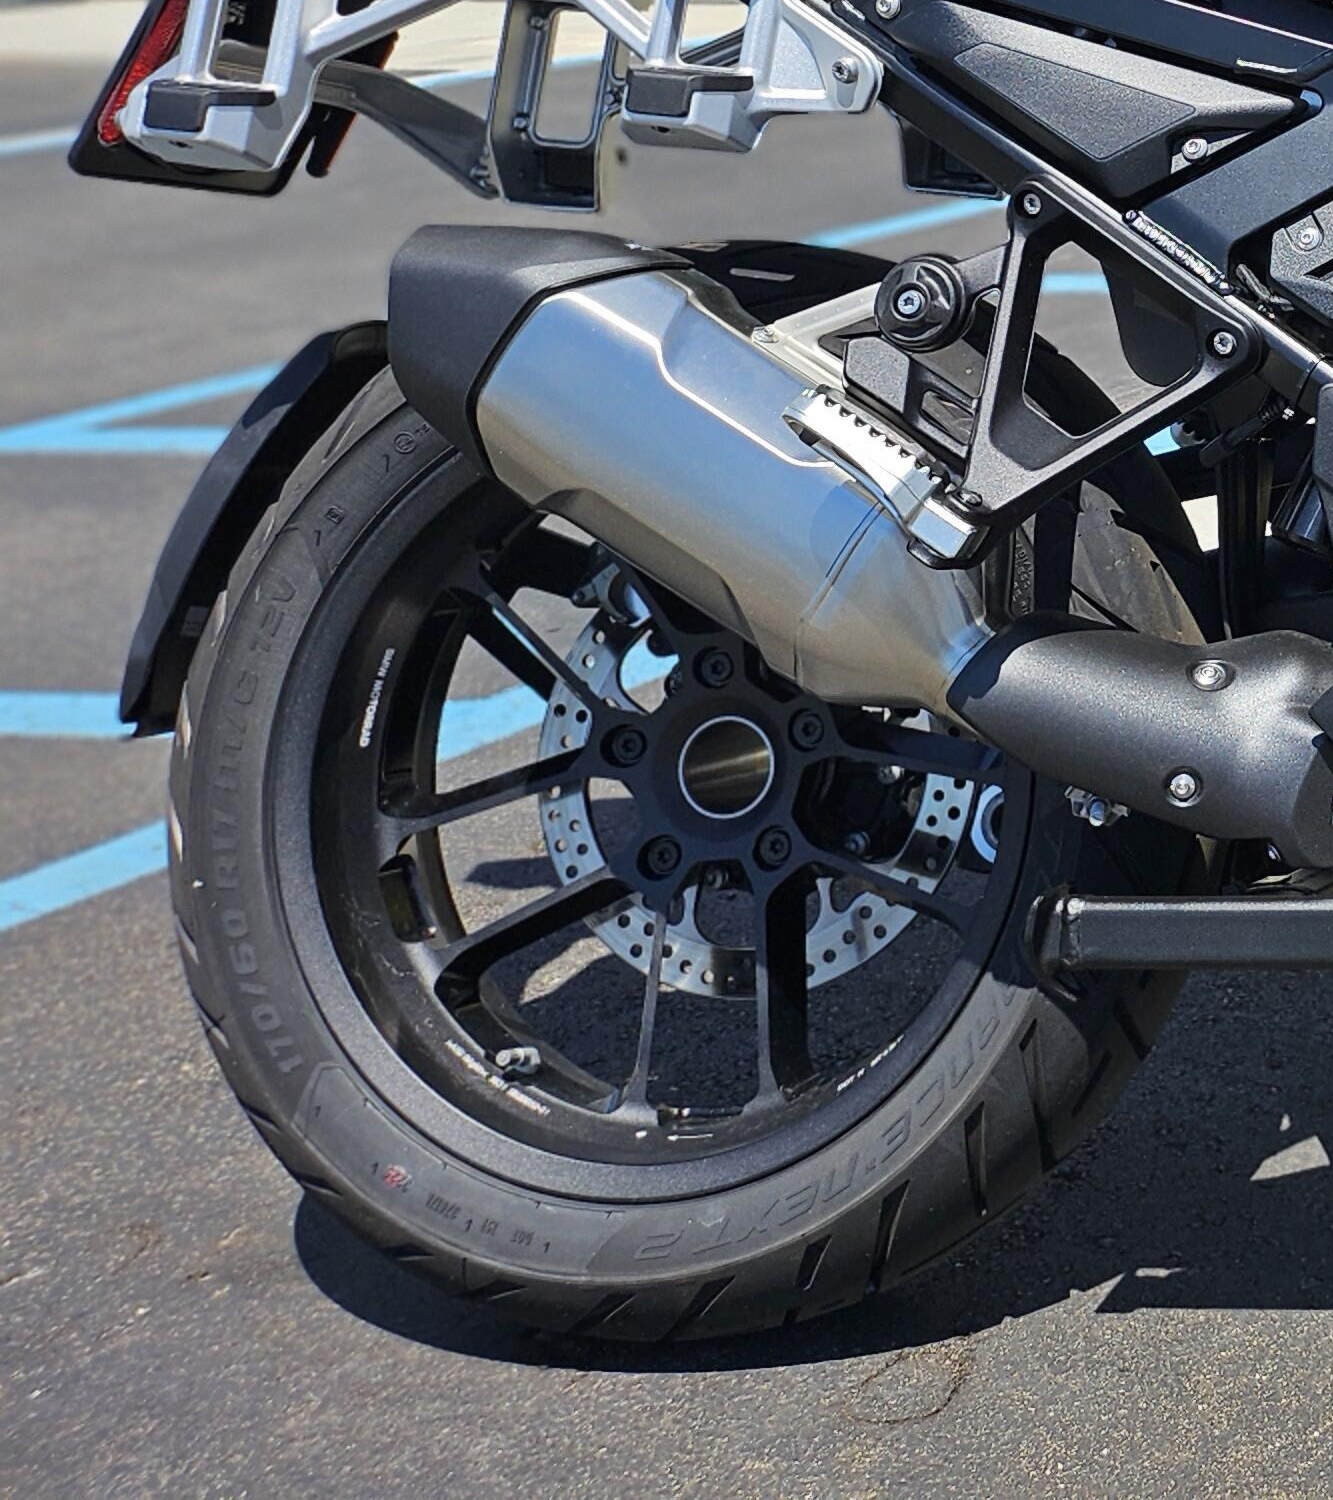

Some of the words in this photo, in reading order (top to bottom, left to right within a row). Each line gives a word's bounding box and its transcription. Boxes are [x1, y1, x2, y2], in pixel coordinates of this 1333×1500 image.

[377, 648, 396, 677] BMW
[359, 679, 385, 747] MOTORRAD
[221, 907, 304, 1075] 170/60
